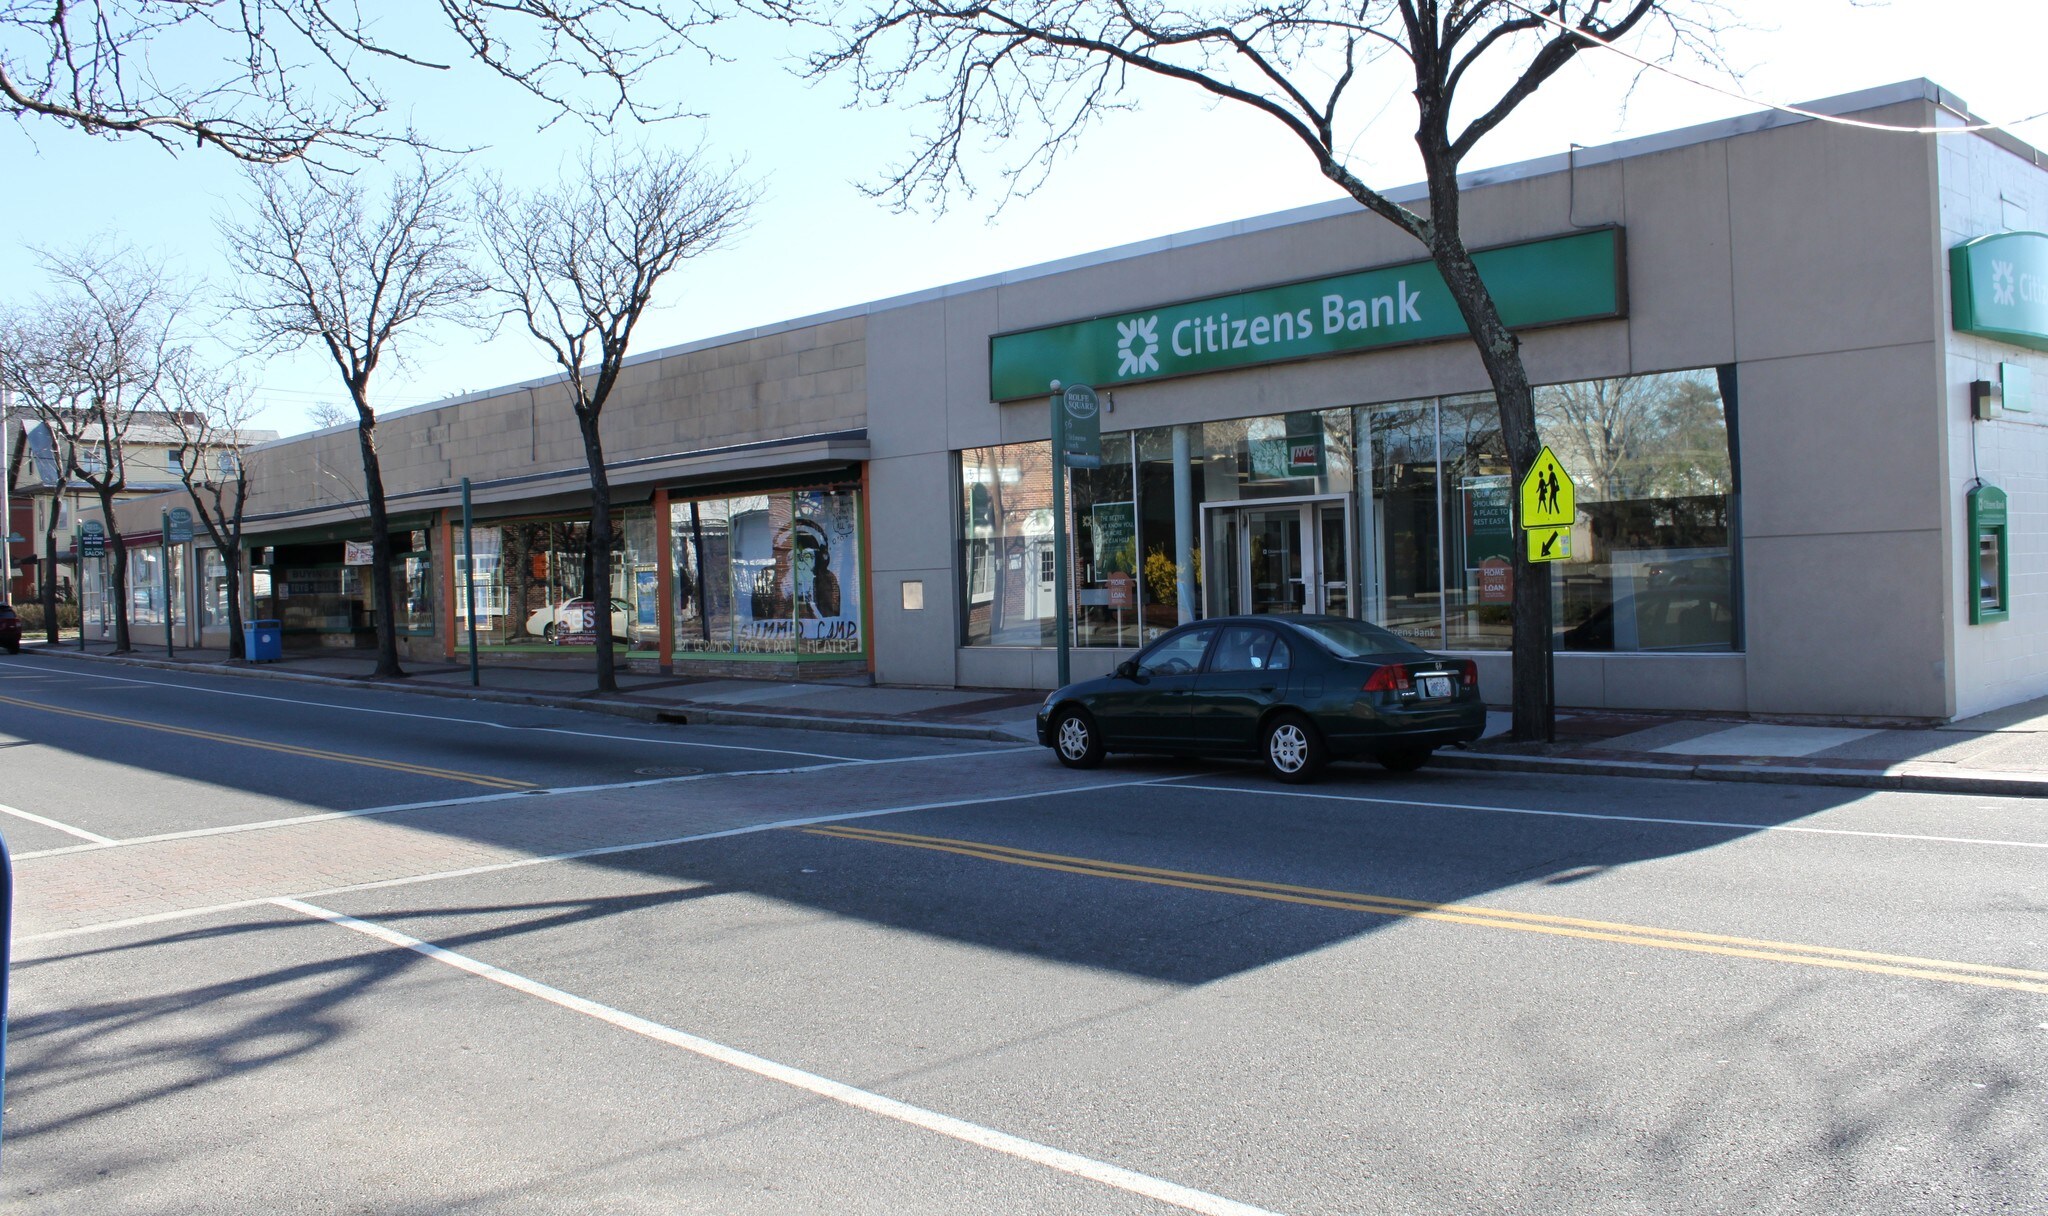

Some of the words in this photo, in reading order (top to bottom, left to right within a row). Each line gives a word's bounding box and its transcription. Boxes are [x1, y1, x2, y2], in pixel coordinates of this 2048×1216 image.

[2020, 273, 2048, 304] Citiz
[1171, 309, 1313, 357] Citizens
[1321, 280, 1422, 336] Bank
[1068, 393, 1090, 402] ROLFE
[1068, 401, 1095, 410] SQUARE
[1065, 420, 1073, 429] 56
[1473, 490, 1490, 498] YOUR
[1484, 568, 1504, 576] HOME
[1484, 584, 1506, 592] LOAN.
[740, 621, 804, 639] SUMMER
[817, 620, 857, 639] CAMP
[1414, 627, 1435, 637] Bank
[740, 640, 760, 653] ROCK
[773, 640, 795, 653] ROLL
